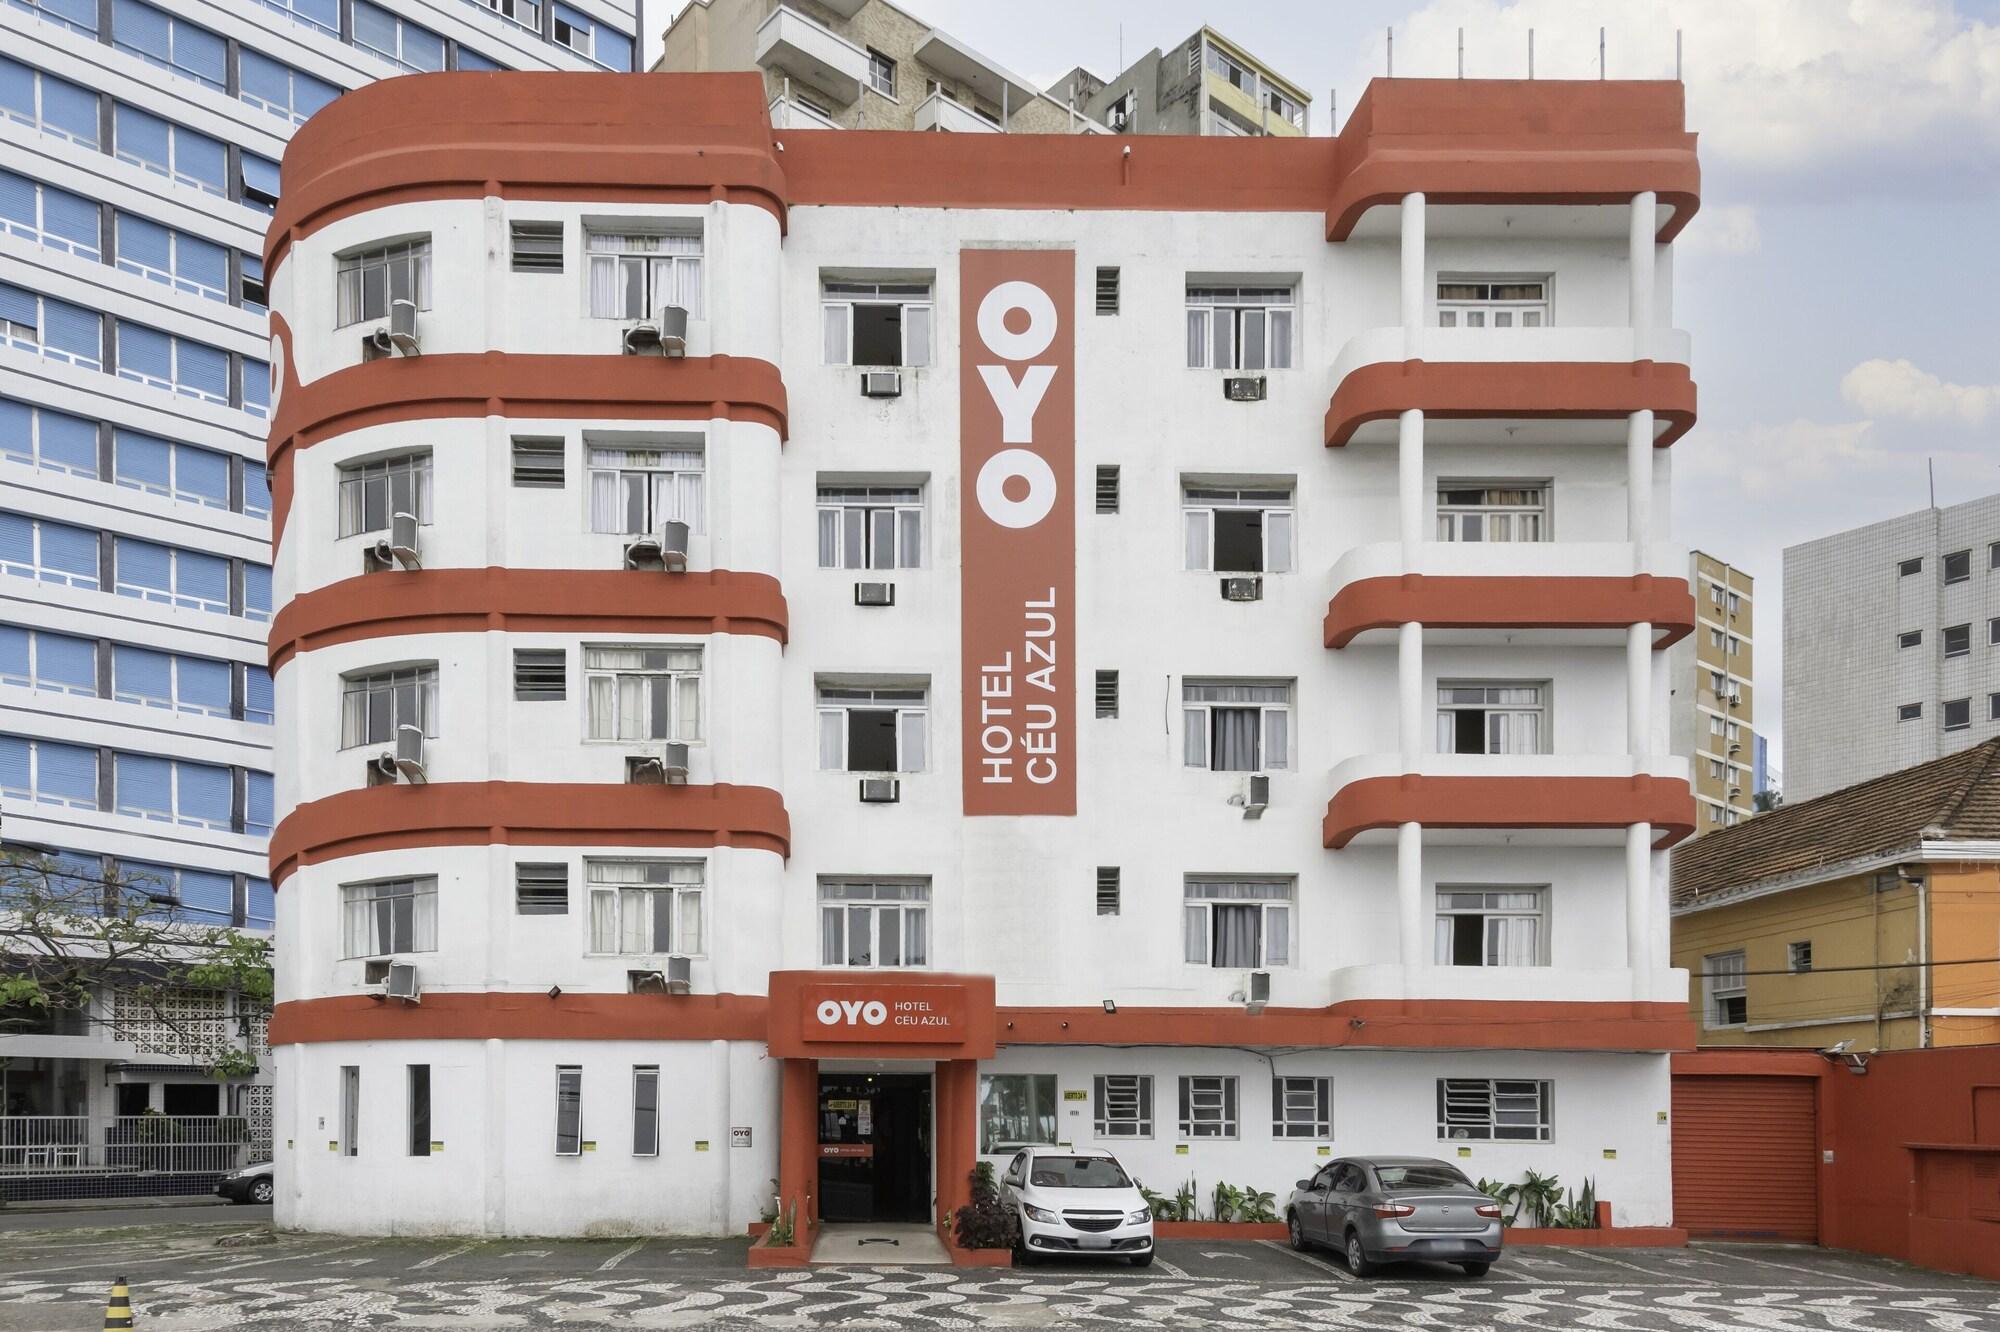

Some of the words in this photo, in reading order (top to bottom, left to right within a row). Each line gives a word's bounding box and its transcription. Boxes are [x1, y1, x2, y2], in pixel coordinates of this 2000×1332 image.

[976, 281, 1058, 528] OYO
[1025, 587, 1056, 692] AZUL
[981, 651, 1012, 784] HOTEL
[1020, 704, 1057, 784] CÉU
[817, 1000, 887, 1025] OYO
[895, 1002, 933, 1011] HOTEL
[921, 1016, 950, 1026] AZUL
